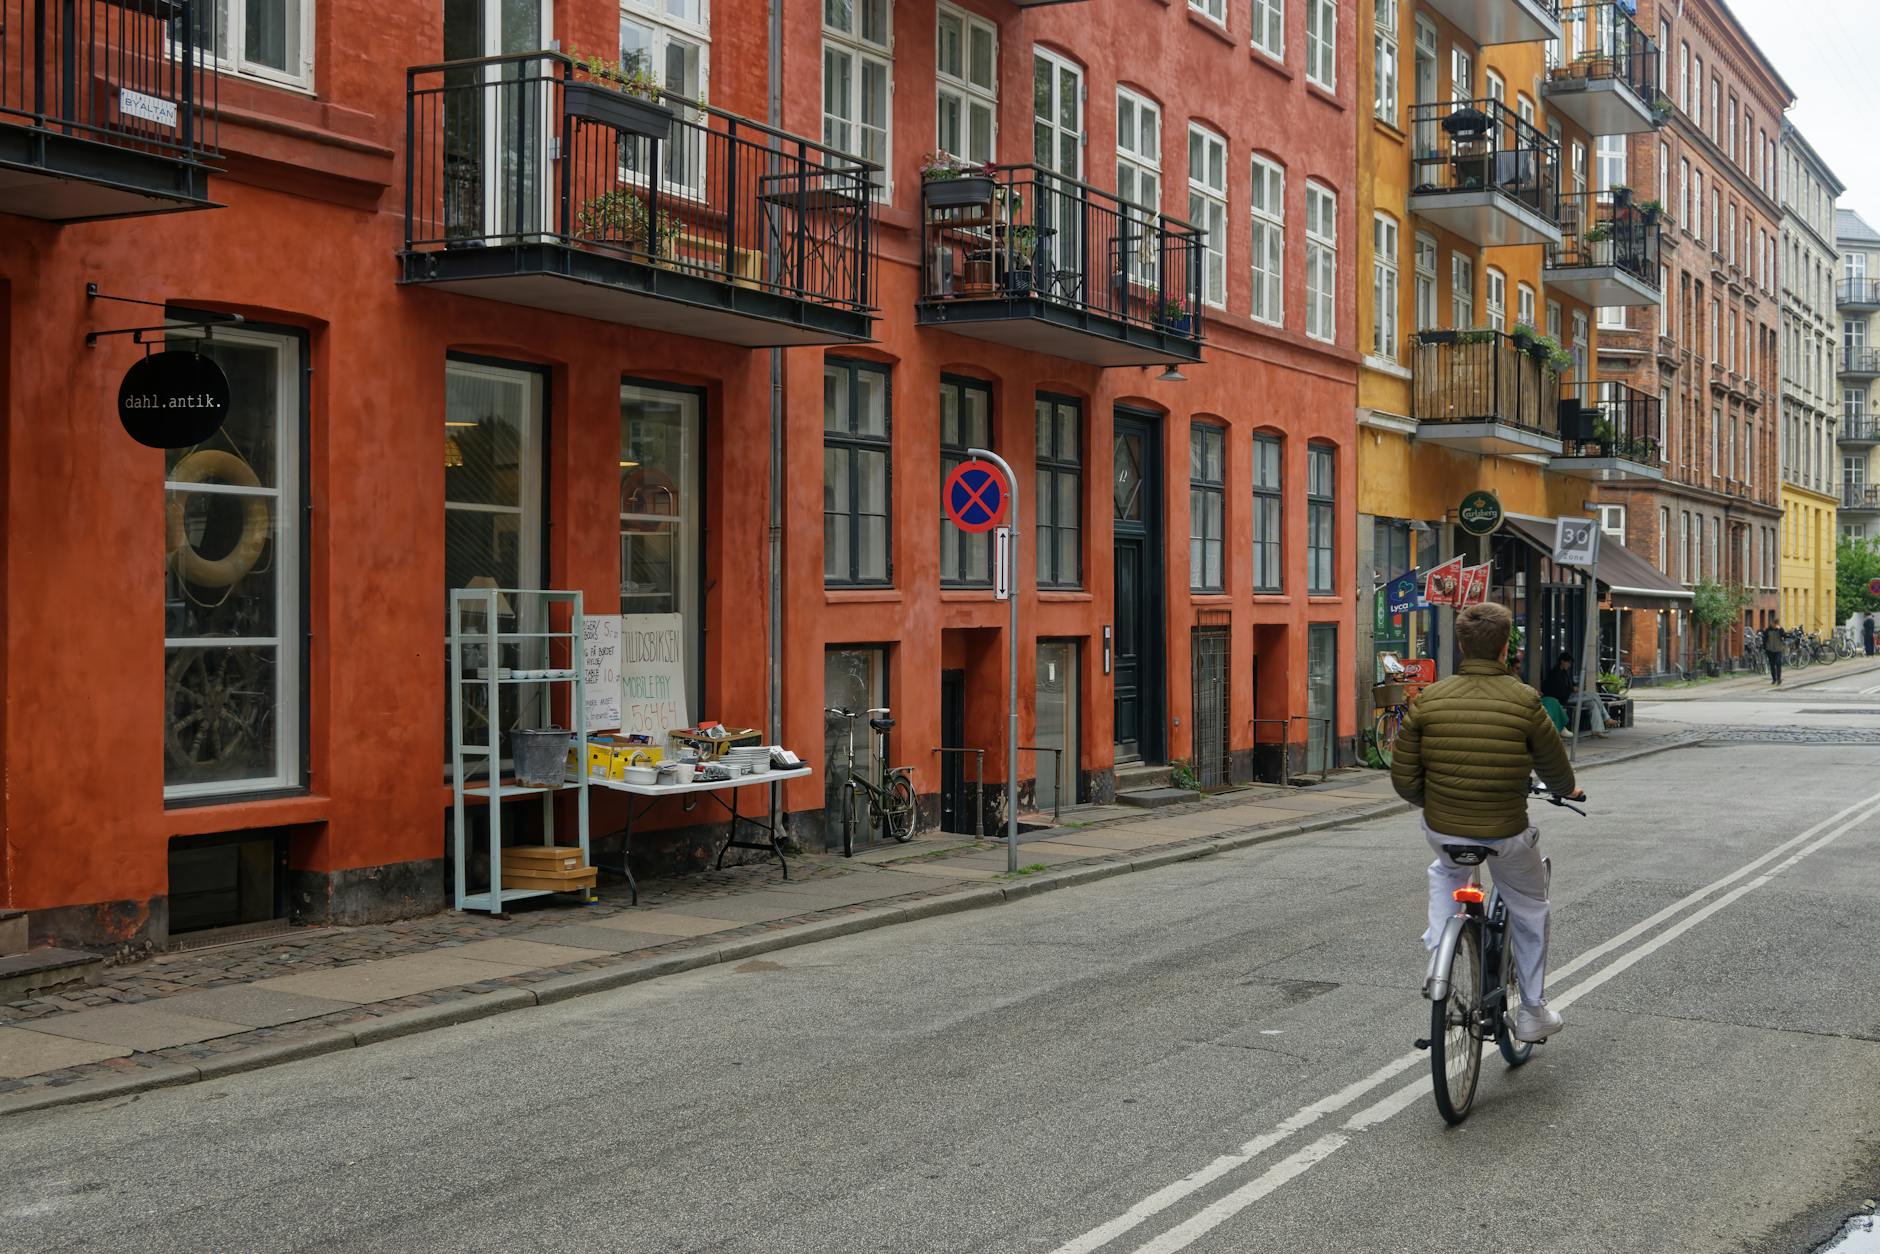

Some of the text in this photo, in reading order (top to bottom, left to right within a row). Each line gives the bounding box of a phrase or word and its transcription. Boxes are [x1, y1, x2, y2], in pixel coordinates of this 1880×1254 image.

[125, 393, 221, 408] dahl.antik.
[1462, 506, 1498, 522] Carlsberg
[1563, 528, 1588, 545] 30
[1390, 602, 1409, 613] Lyca
